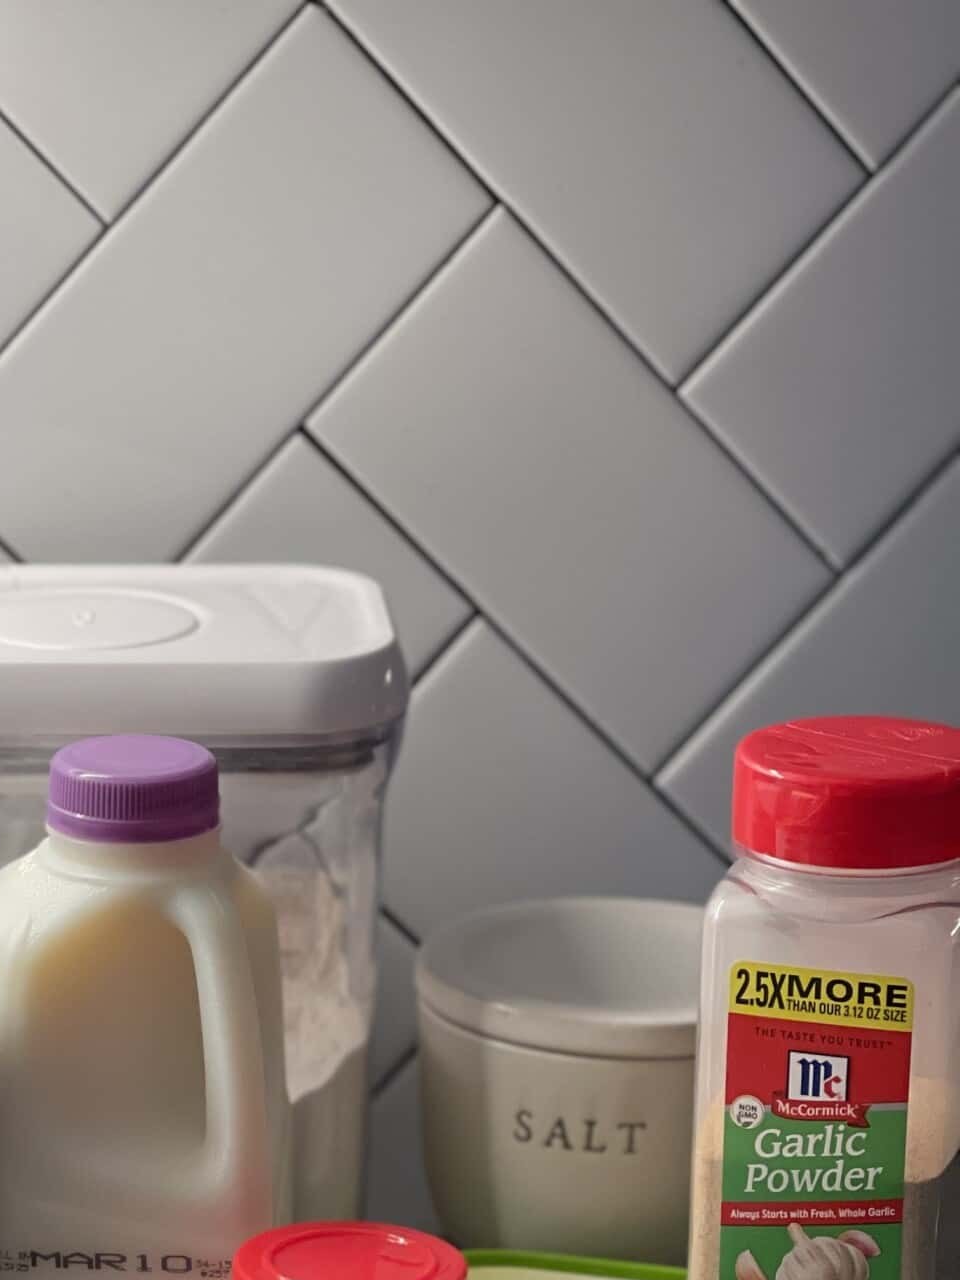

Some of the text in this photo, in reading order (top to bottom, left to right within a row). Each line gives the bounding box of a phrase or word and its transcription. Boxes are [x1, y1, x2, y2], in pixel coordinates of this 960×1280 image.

[736, 967, 908, 1009] 2.5X MORE
[787, 999, 907, 1023] THAN OUR 3.12 OZ SIZE
[755, 1026, 777, 1037] THE
[780, 1029, 815, 1043] TASTE
[819, 1033, 844, 1046] YOU
[777, 1099, 857, 1119] McCormick
[513, 1109, 648, 1154] SALT
[755, 1124, 867, 1159] Garlic
[744, 1160, 884, 1194] Powder
[730, 1208, 760, 1220] Always
[761, 1209, 788, 1220] Starts
[790, 1209, 809, 1220] with
[839, 1207, 867, 1218] Whole
[868, 1206, 896, 1219] Garlic
[31, 1251, 127, 1271] MAR
[137, 1254, 193, 1273] 10
